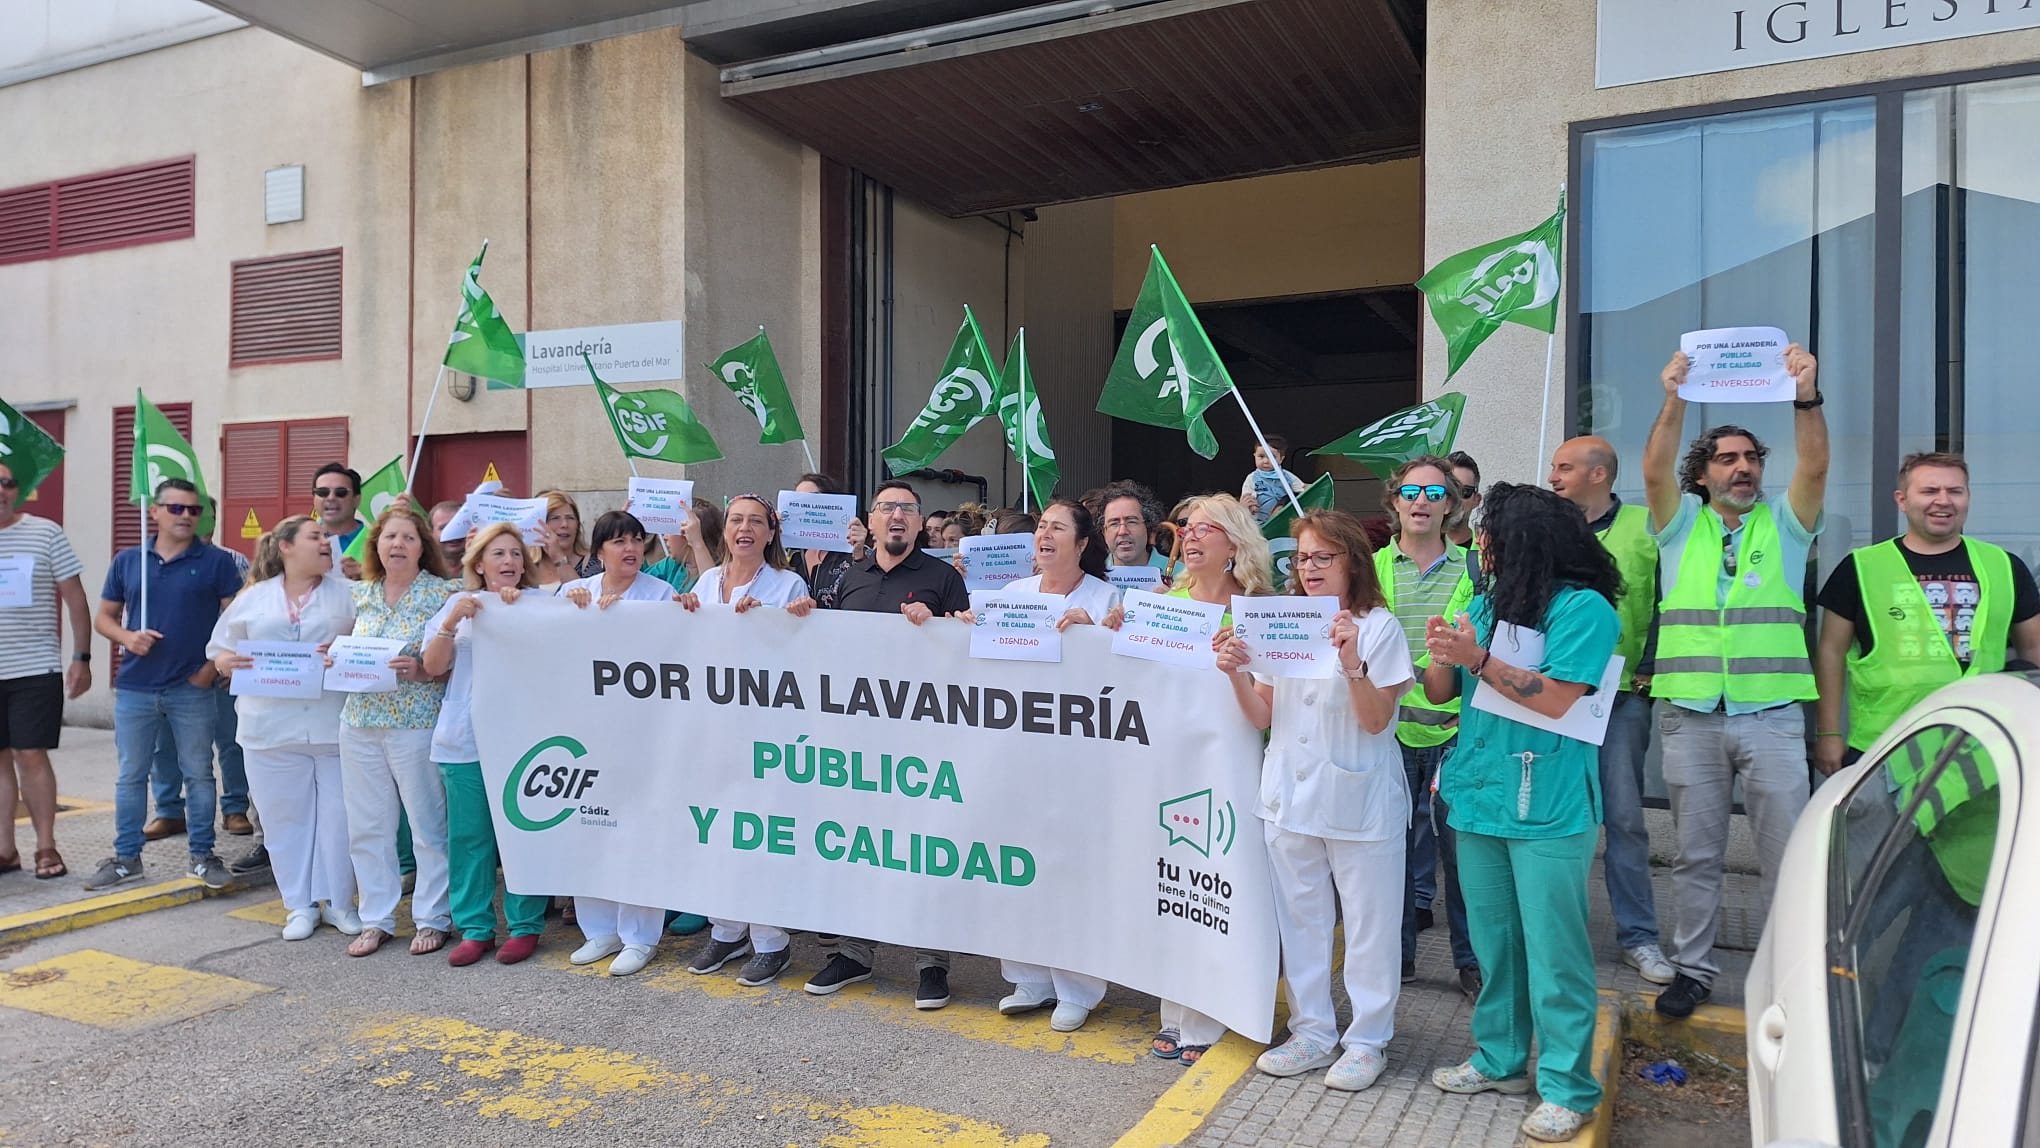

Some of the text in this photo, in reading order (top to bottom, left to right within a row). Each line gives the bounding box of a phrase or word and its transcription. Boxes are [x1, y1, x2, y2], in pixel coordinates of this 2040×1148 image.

[1733, 0, 2033, 51] IGLES
[532, 337, 612, 359] Lavandería
[1731, 339, 1777, 348] LAVANDERÍA
[1720, 351, 1752, 359] PÚBLICA
[532, 363, 563, 375] Hospital
[614, 359, 640, 369] Puerta
[641, 358, 654, 367] del
[655, 357, 671, 367] Mar
[1711, 379, 1771, 388] INVERSION
[618, 408, 667, 434] CSIF
[799, 530, 839, 539] INVERSION
[1003, 611, 1028, 619] PÚBLICA
[1138, 601, 1151, 609] POR
[1167, 606, 1206, 618] LAVANDERÍA
[1278, 611, 1322, 619] LAVANDERÍA
[1155, 613, 1182, 622] PÚBLICA
[1161, 623, 1188, 633] CALIDAD
[1268, 621, 1300, 629] PÚBLICA
[999, 637, 1040, 646] DIGNIDAD
[1128, 634, 1194, 651] CSIF EN LUCHA
[1265, 651, 1316, 661] PERSONAL
[593, 660, 1150, 746] POR UNA LAVANDERÍA
[753, 735, 963, 803] PÚBLICA
[523, 764, 600, 800] CSIF
[580, 805, 610, 817] Cádiz
[581, 817, 618, 828] Sanidad
[688, 805, 1036, 887] Y DE CALIDAD
[1157, 857, 1233, 900] tu voto
[1158, 882, 1230, 915] tiene la última
[1158, 898, 1229, 936] palabra
